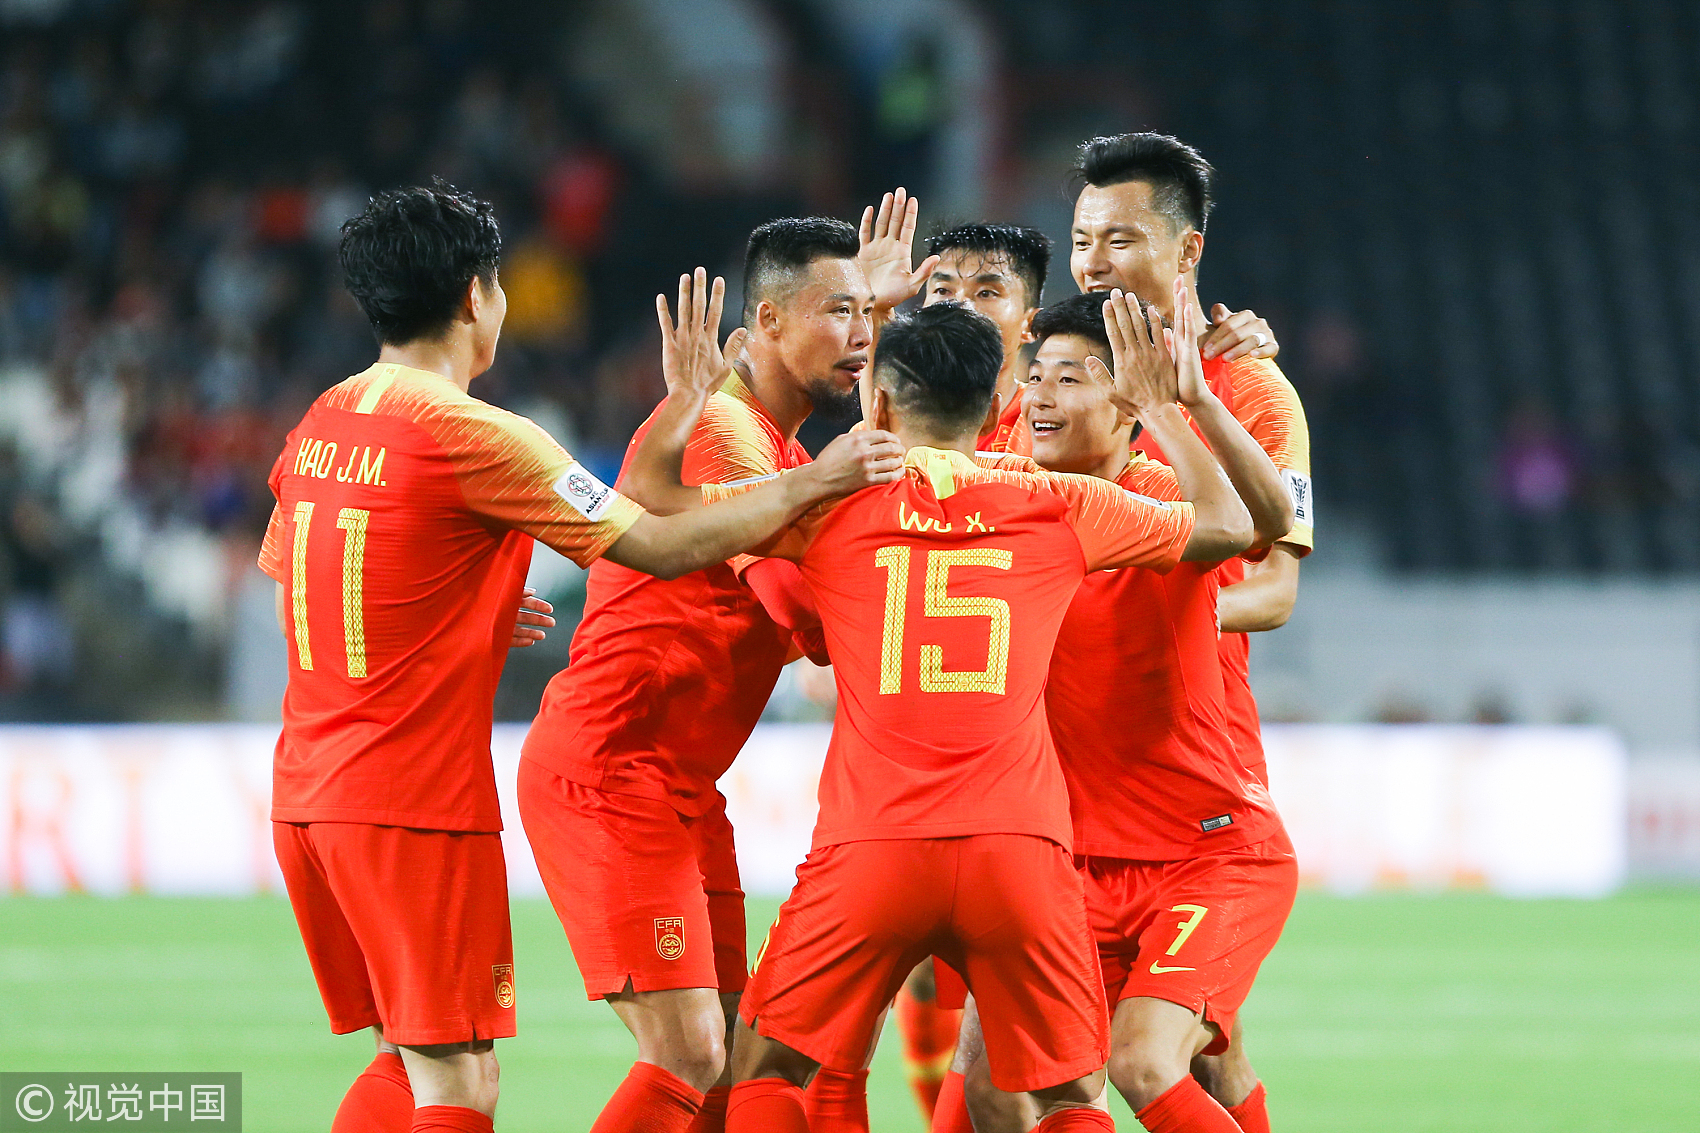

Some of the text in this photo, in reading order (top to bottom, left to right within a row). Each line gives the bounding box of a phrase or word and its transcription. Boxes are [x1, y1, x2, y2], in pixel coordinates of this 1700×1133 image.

[293, 438, 387, 487] HAO J.M.
[586, 496, 601, 514] ASIAN
[292, 501, 370, 678] 11
[875, 545, 1013, 695] 15
[656, 919, 682, 929] CFA
[1164, 903, 1209, 956] 7
[494, 966, 511, 976] CFA
